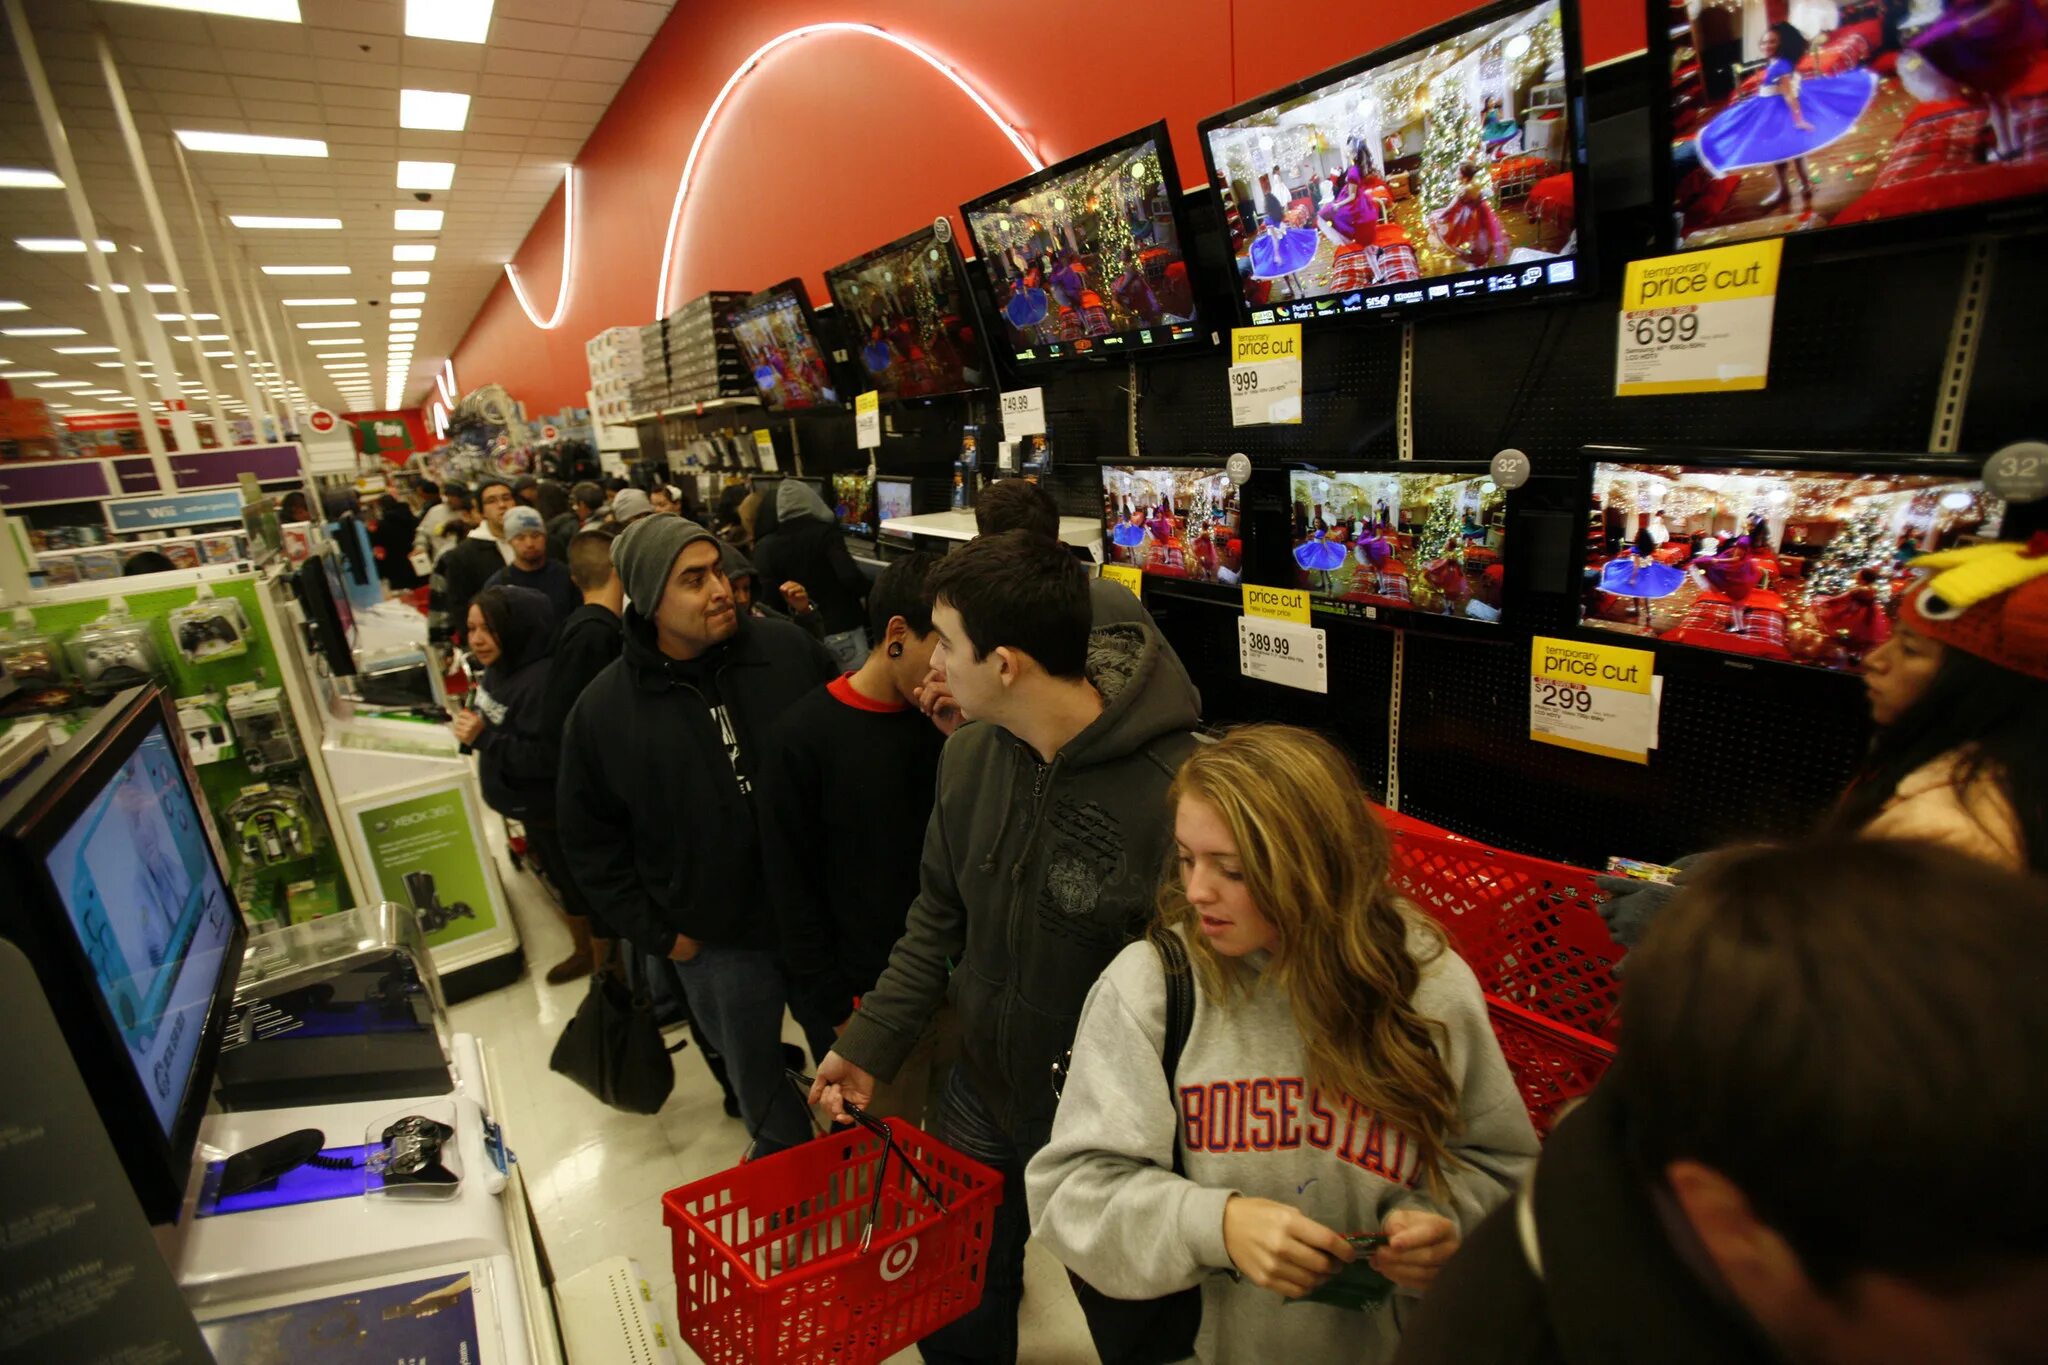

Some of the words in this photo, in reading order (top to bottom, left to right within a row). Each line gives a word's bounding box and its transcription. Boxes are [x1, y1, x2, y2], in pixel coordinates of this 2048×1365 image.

[1643, 261, 1712, 278] temporary
[1640, 273, 1708, 304] price
[1714, 261, 1762, 290] cut
[1626, 313, 1699, 346] $699
[1238, 341, 1269, 359] price
[1271, 337, 1294, 355] cut
[1231, 371, 1258, 391] $999
[1003, 395, 1028, 411] 749.99
[1249, 588, 1279, 605] price
[1281, 595, 1302, 609] cut
[1262, 607, 1276, 615] lower
[1277, 610, 1292, 618] price
[1248, 632, 1290, 655] 389.99
[1545, 646, 1600, 662] temporary
[1544, 655, 1597, 676] price
[1602, 665, 1638, 683] cut
[1534, 684, 1592, 713] $299
[1179, 1076, 1304, 1153] BOISE
